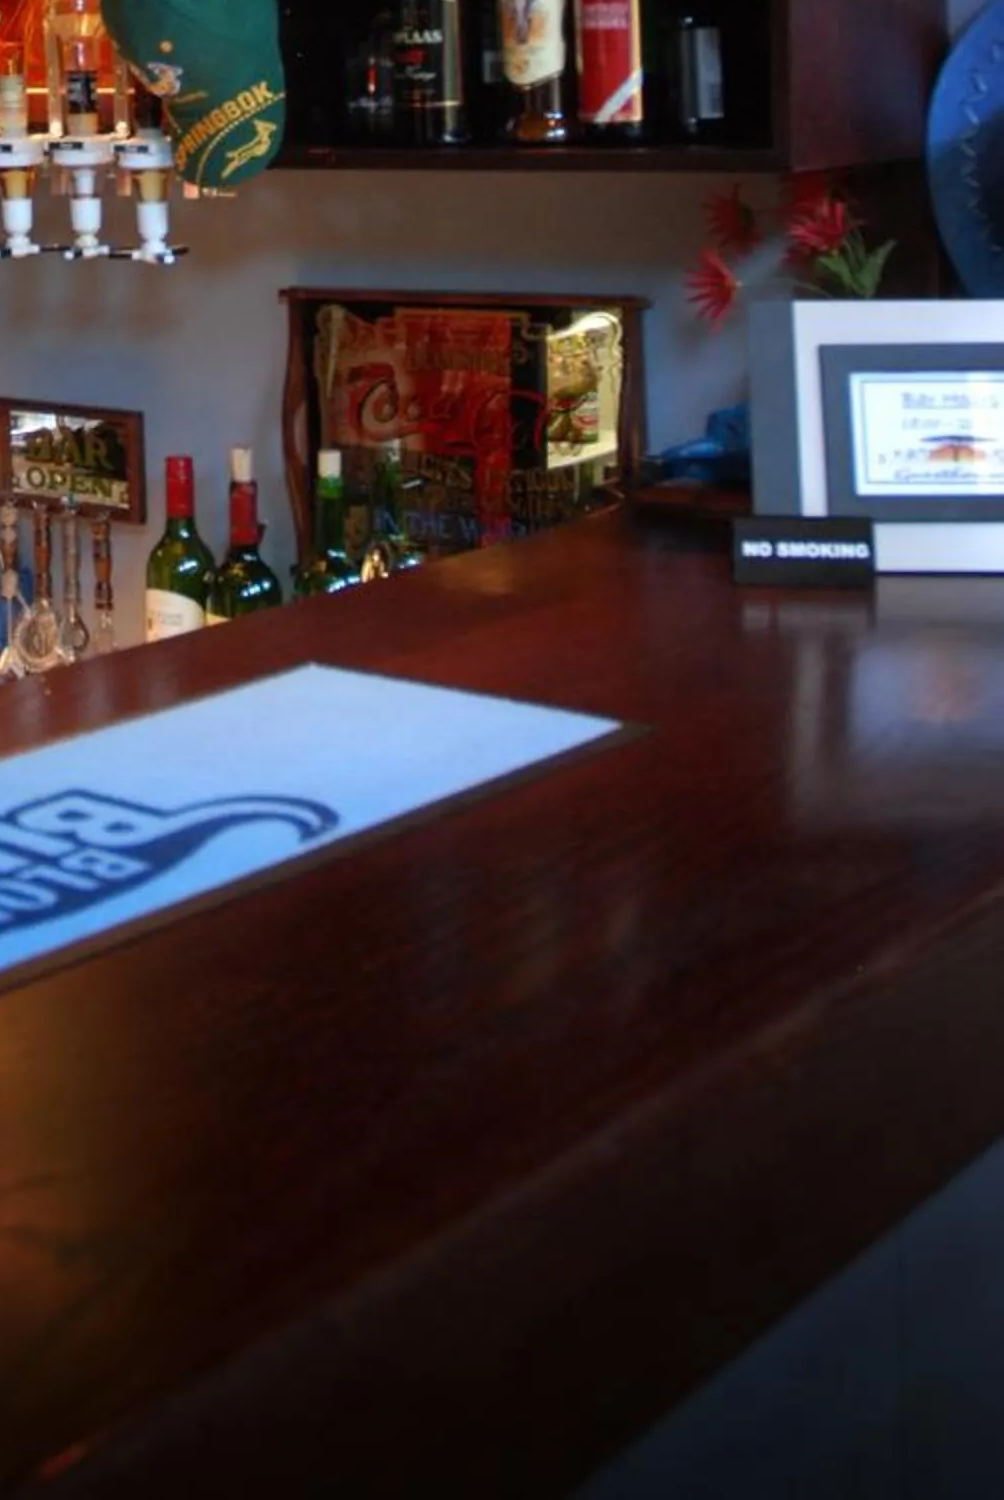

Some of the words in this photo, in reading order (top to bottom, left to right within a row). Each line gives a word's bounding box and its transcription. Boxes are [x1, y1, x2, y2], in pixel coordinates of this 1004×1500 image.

[26, 465, 113, 499] OPEN
[742, 541, 773, 557] NO
[776, 541, 871, 559] SMOKING
